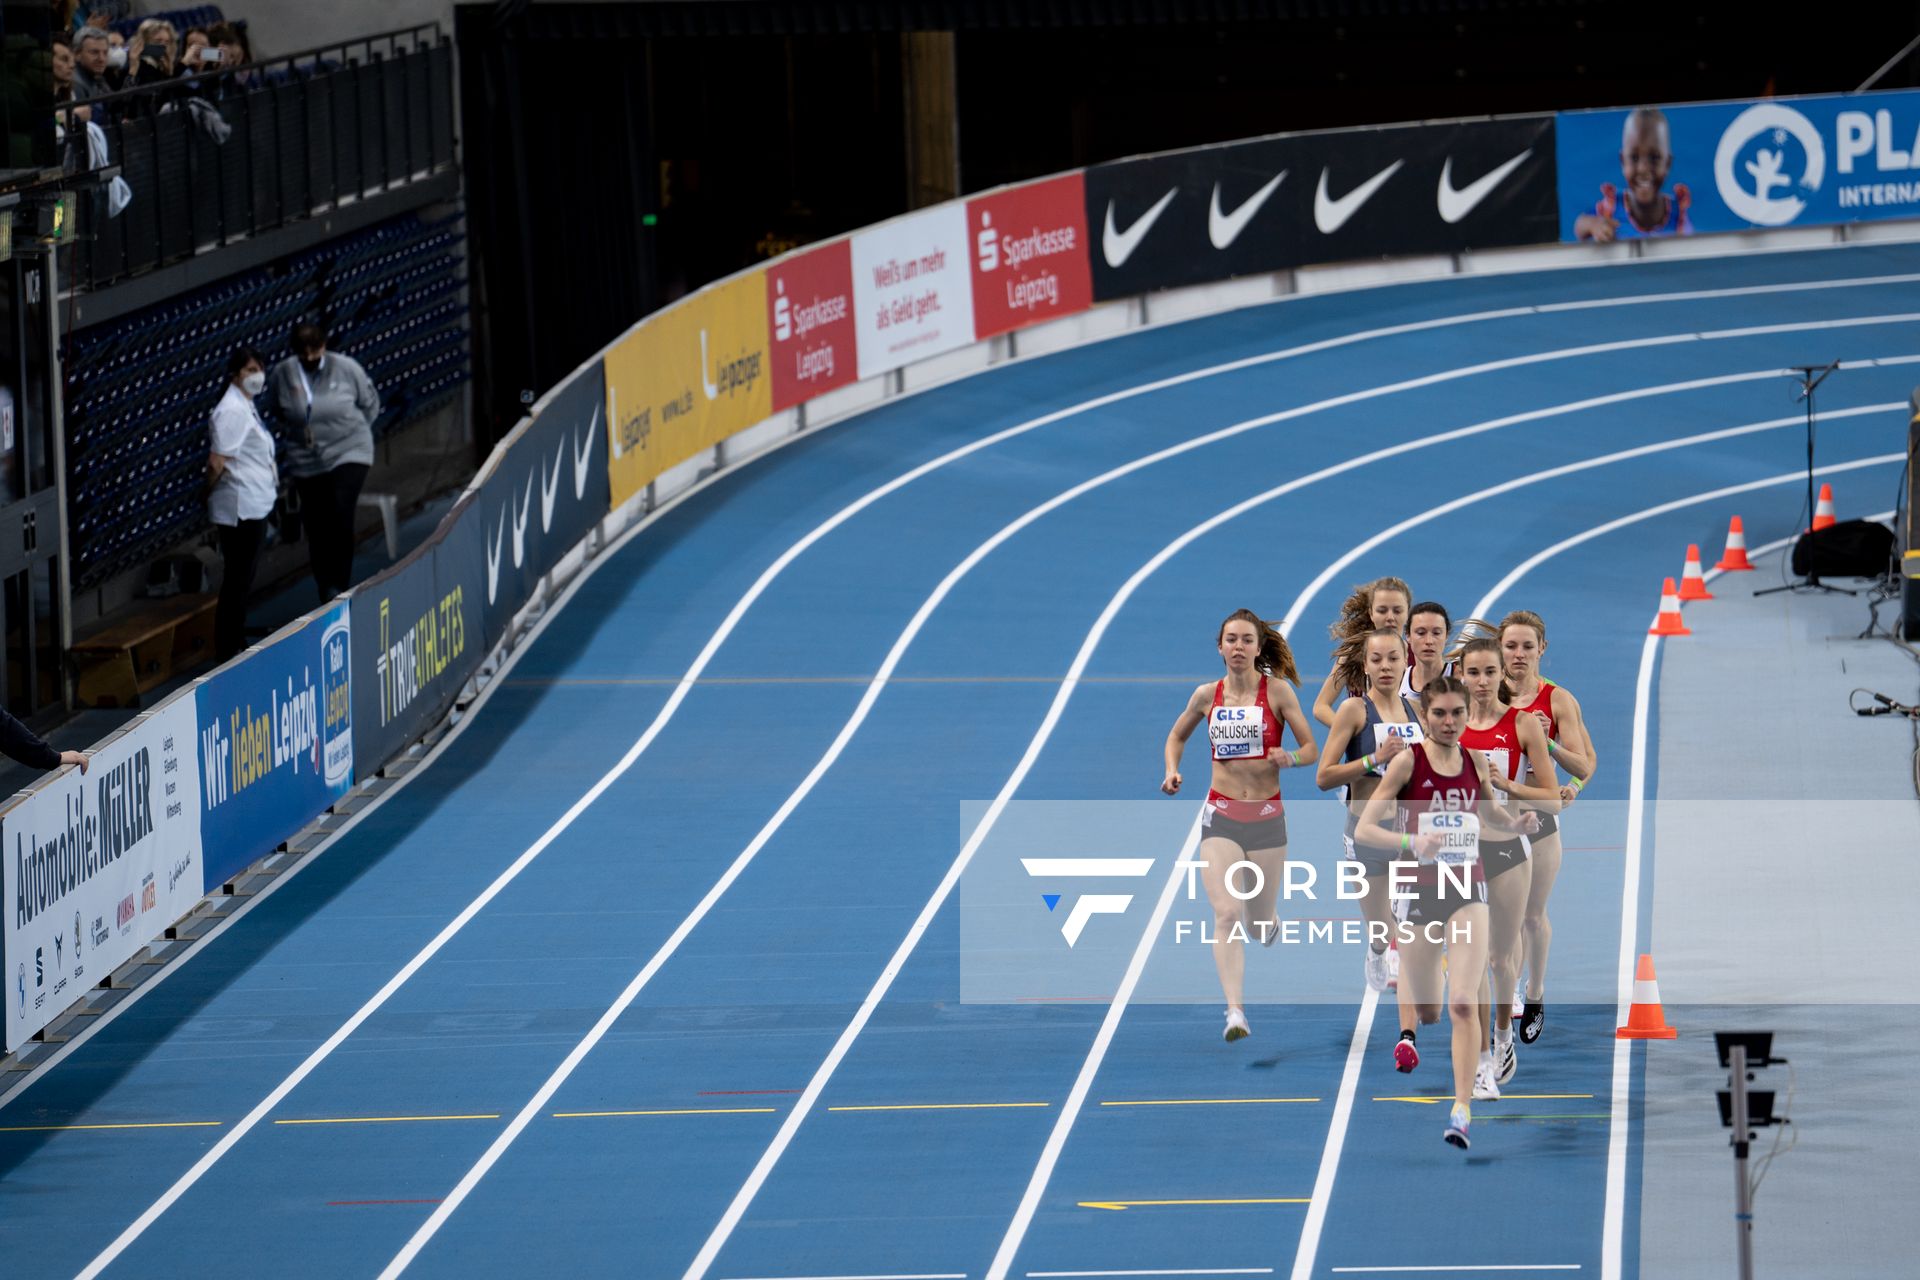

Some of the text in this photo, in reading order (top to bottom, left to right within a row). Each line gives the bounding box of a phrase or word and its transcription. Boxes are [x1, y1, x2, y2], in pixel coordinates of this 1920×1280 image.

[1836, 108, 1920, 174] PL
[903, 259, 918, 281] um
[920, 245, 946, 275] mehr
[1002, 226, 1075, 271] Sparkasse
[1007, 268, 1058, 311] Leipzig
[793, 294, 846, 340] Sparkasse
[877, 303, 891, 331] als
[891, 296, 914, 325] Geld
[796, 340, 833, 383] Leipzig
[203, 665, 317, 811] Wir lieben Leipzig
[1428, 788, 1476, 812] ASV
[17, 746, 153, 930] Automobile: MÜLLER
